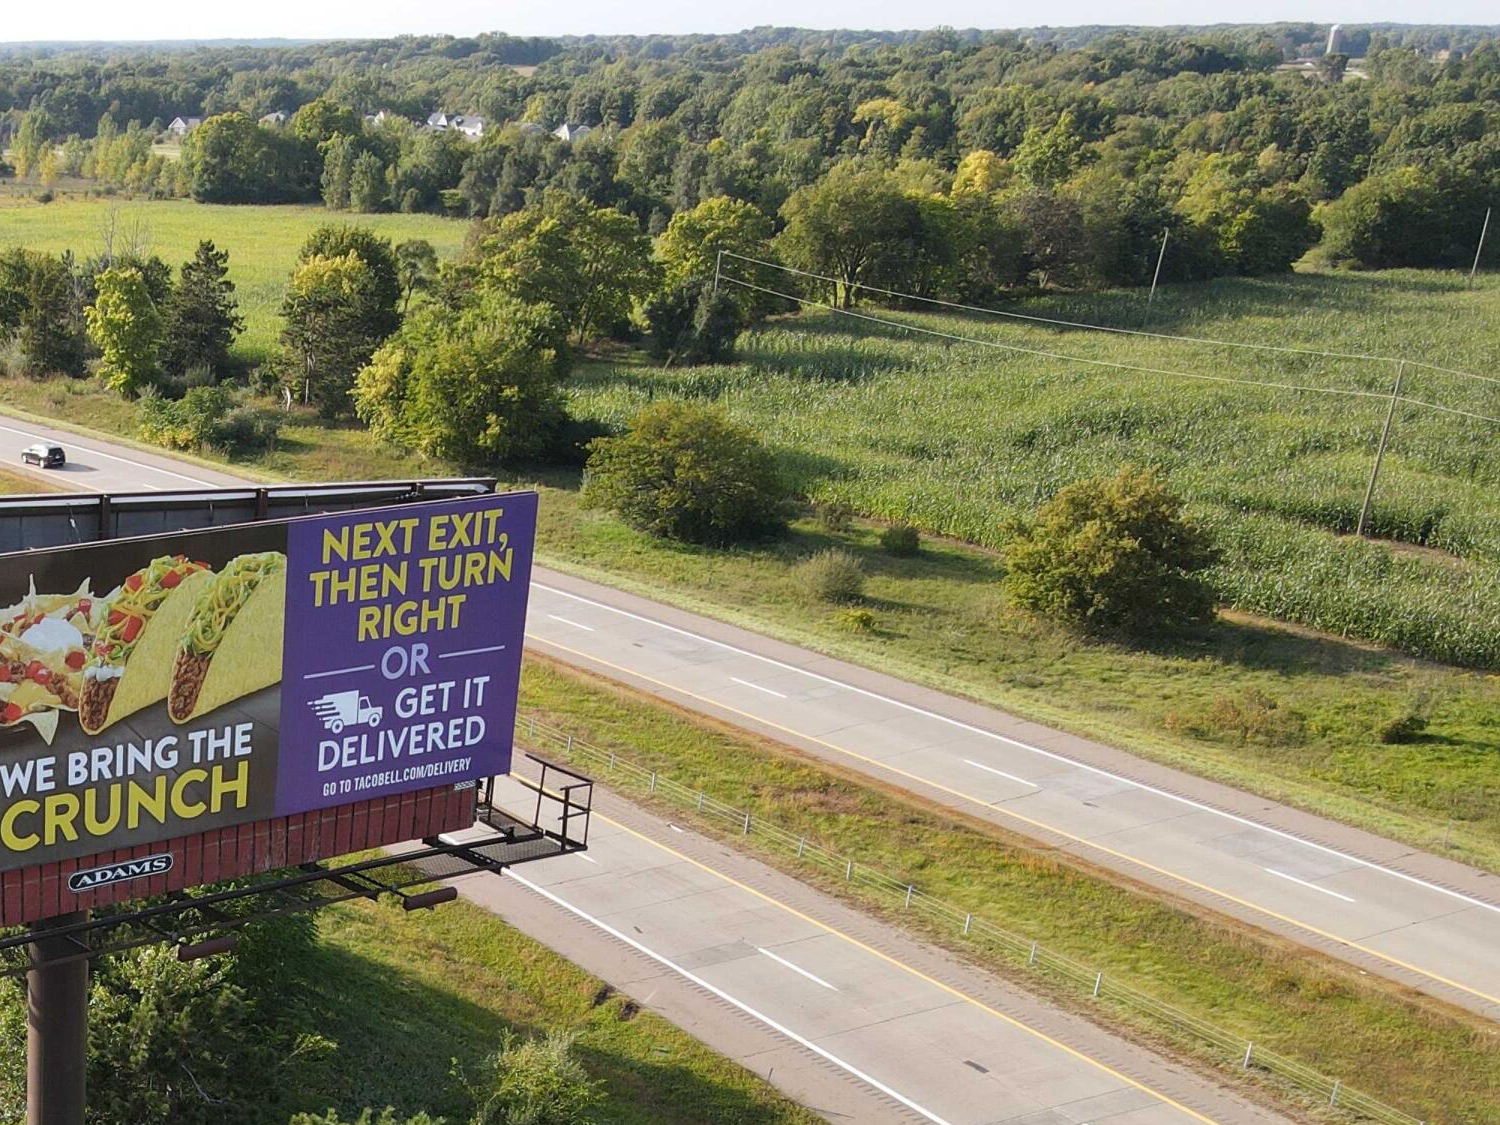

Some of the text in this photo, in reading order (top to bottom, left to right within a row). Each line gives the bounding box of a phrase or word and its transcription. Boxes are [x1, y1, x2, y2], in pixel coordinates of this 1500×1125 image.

[322, 508, 508, 564] NEXT EXIT,
[309, 548, 514, 608] THEN TURN
[357, 594, 466, 642] RIGHT
[380, 642, 431, 680] OR
[394, 676, 490, 718] GET IT
[0, 722, 254, 798] WE BRING THE
[317, 715, 486, 772] DELIVERED
[322, 756, 472, 796] GO TO TACOBELL.COM/DELIVERY
[0, 760, 248, 851] CRUNCH
[76, 858, 167, 888] ADAMS
